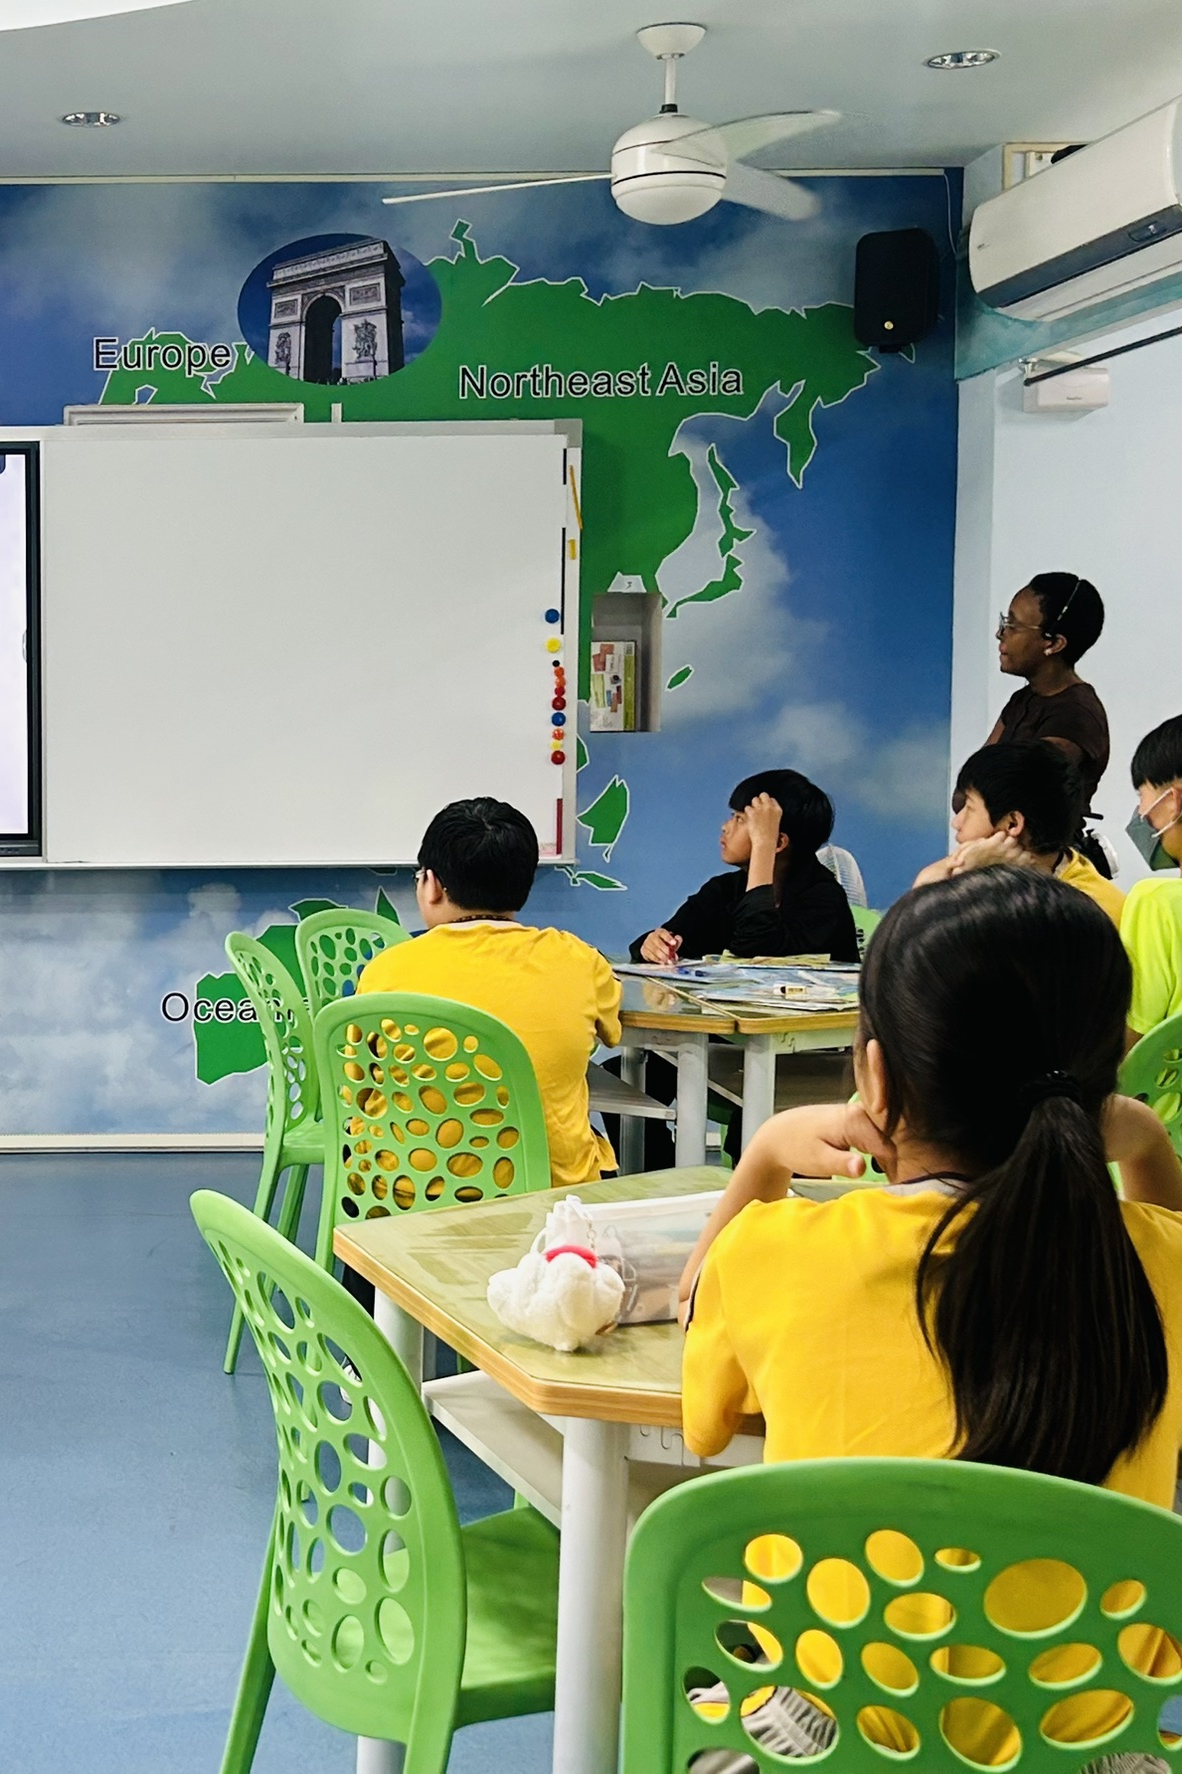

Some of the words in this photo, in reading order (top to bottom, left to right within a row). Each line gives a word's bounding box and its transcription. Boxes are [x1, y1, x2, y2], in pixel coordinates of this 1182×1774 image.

[94, 337, 232, 377] Europe
[459, 364, 651, 399] Northeast
[656, 361, 744, 396] Asia
